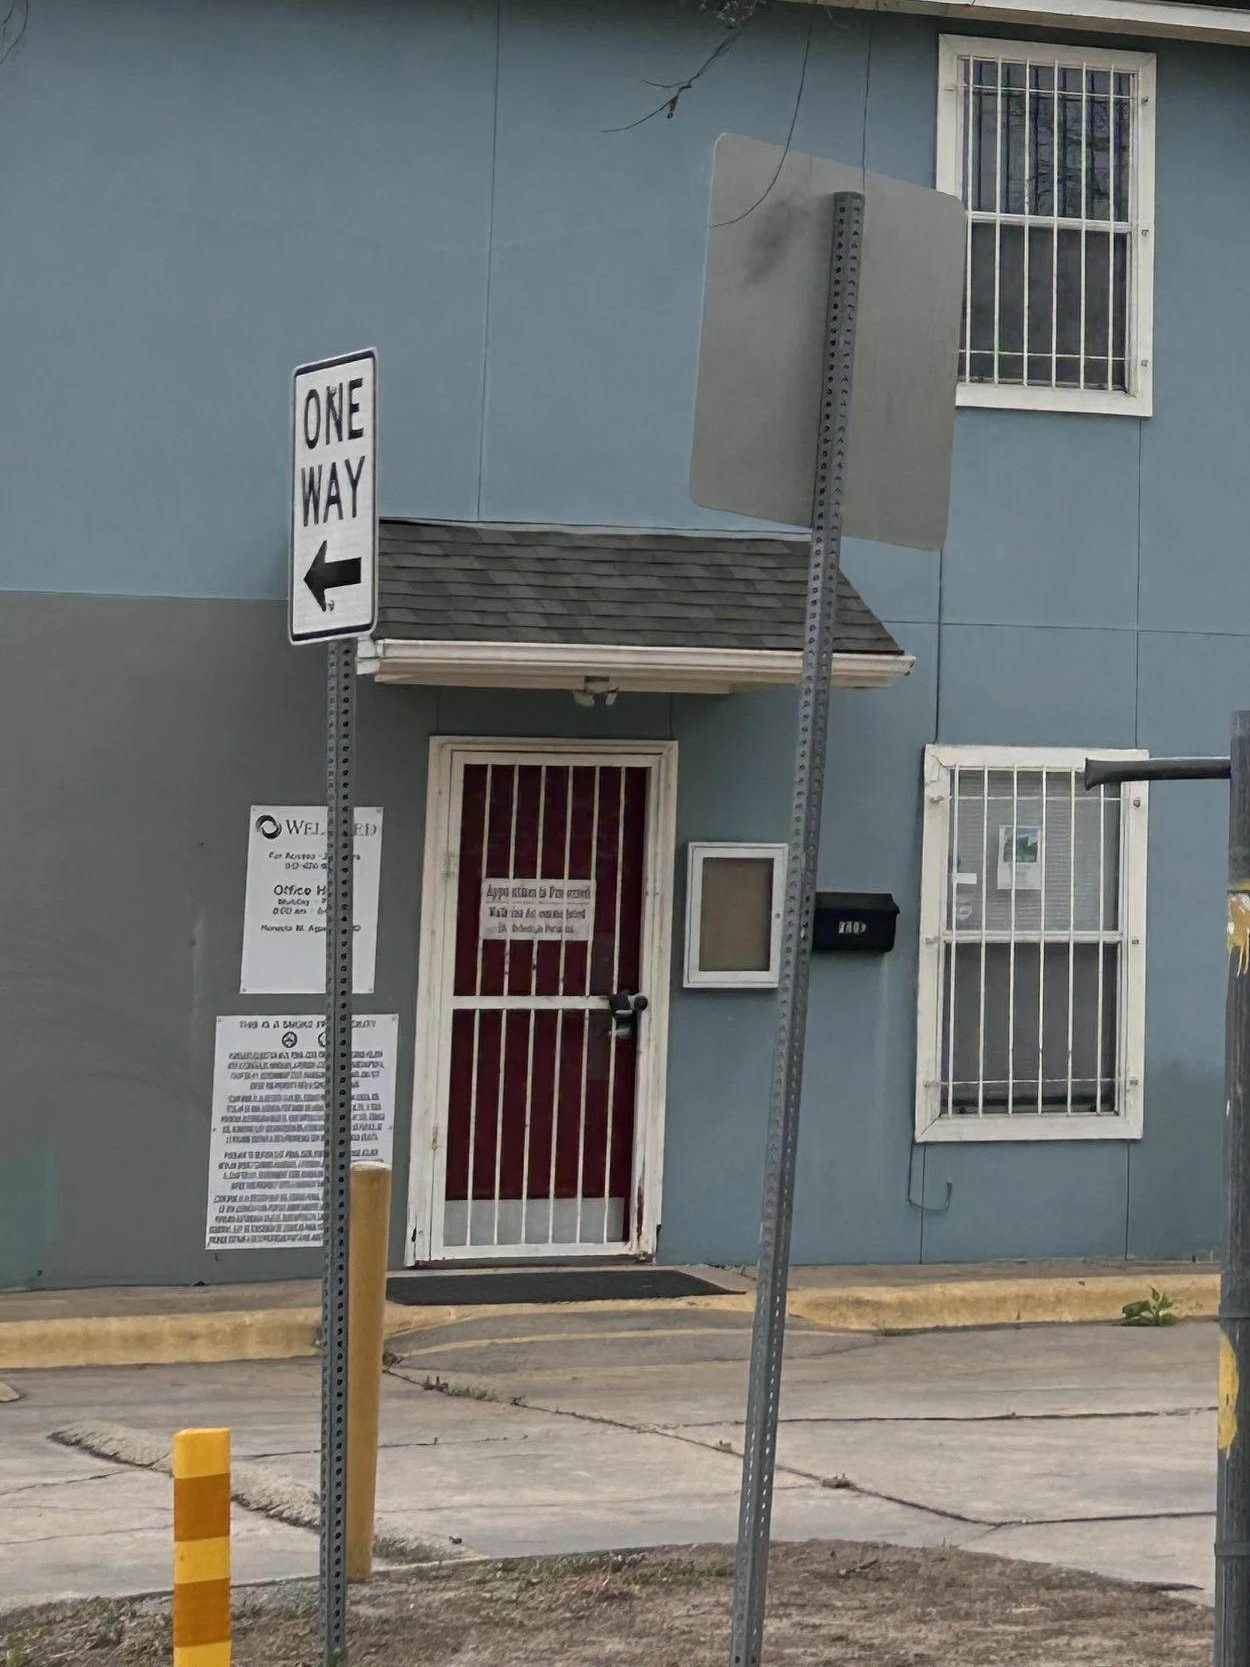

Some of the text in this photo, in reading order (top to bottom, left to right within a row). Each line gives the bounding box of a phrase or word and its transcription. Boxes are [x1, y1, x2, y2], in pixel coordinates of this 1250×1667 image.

[303, 377, 365, 450] ONE
[301, 455, 366, 527] WAY
[285, 819, 378, 836] WELED
